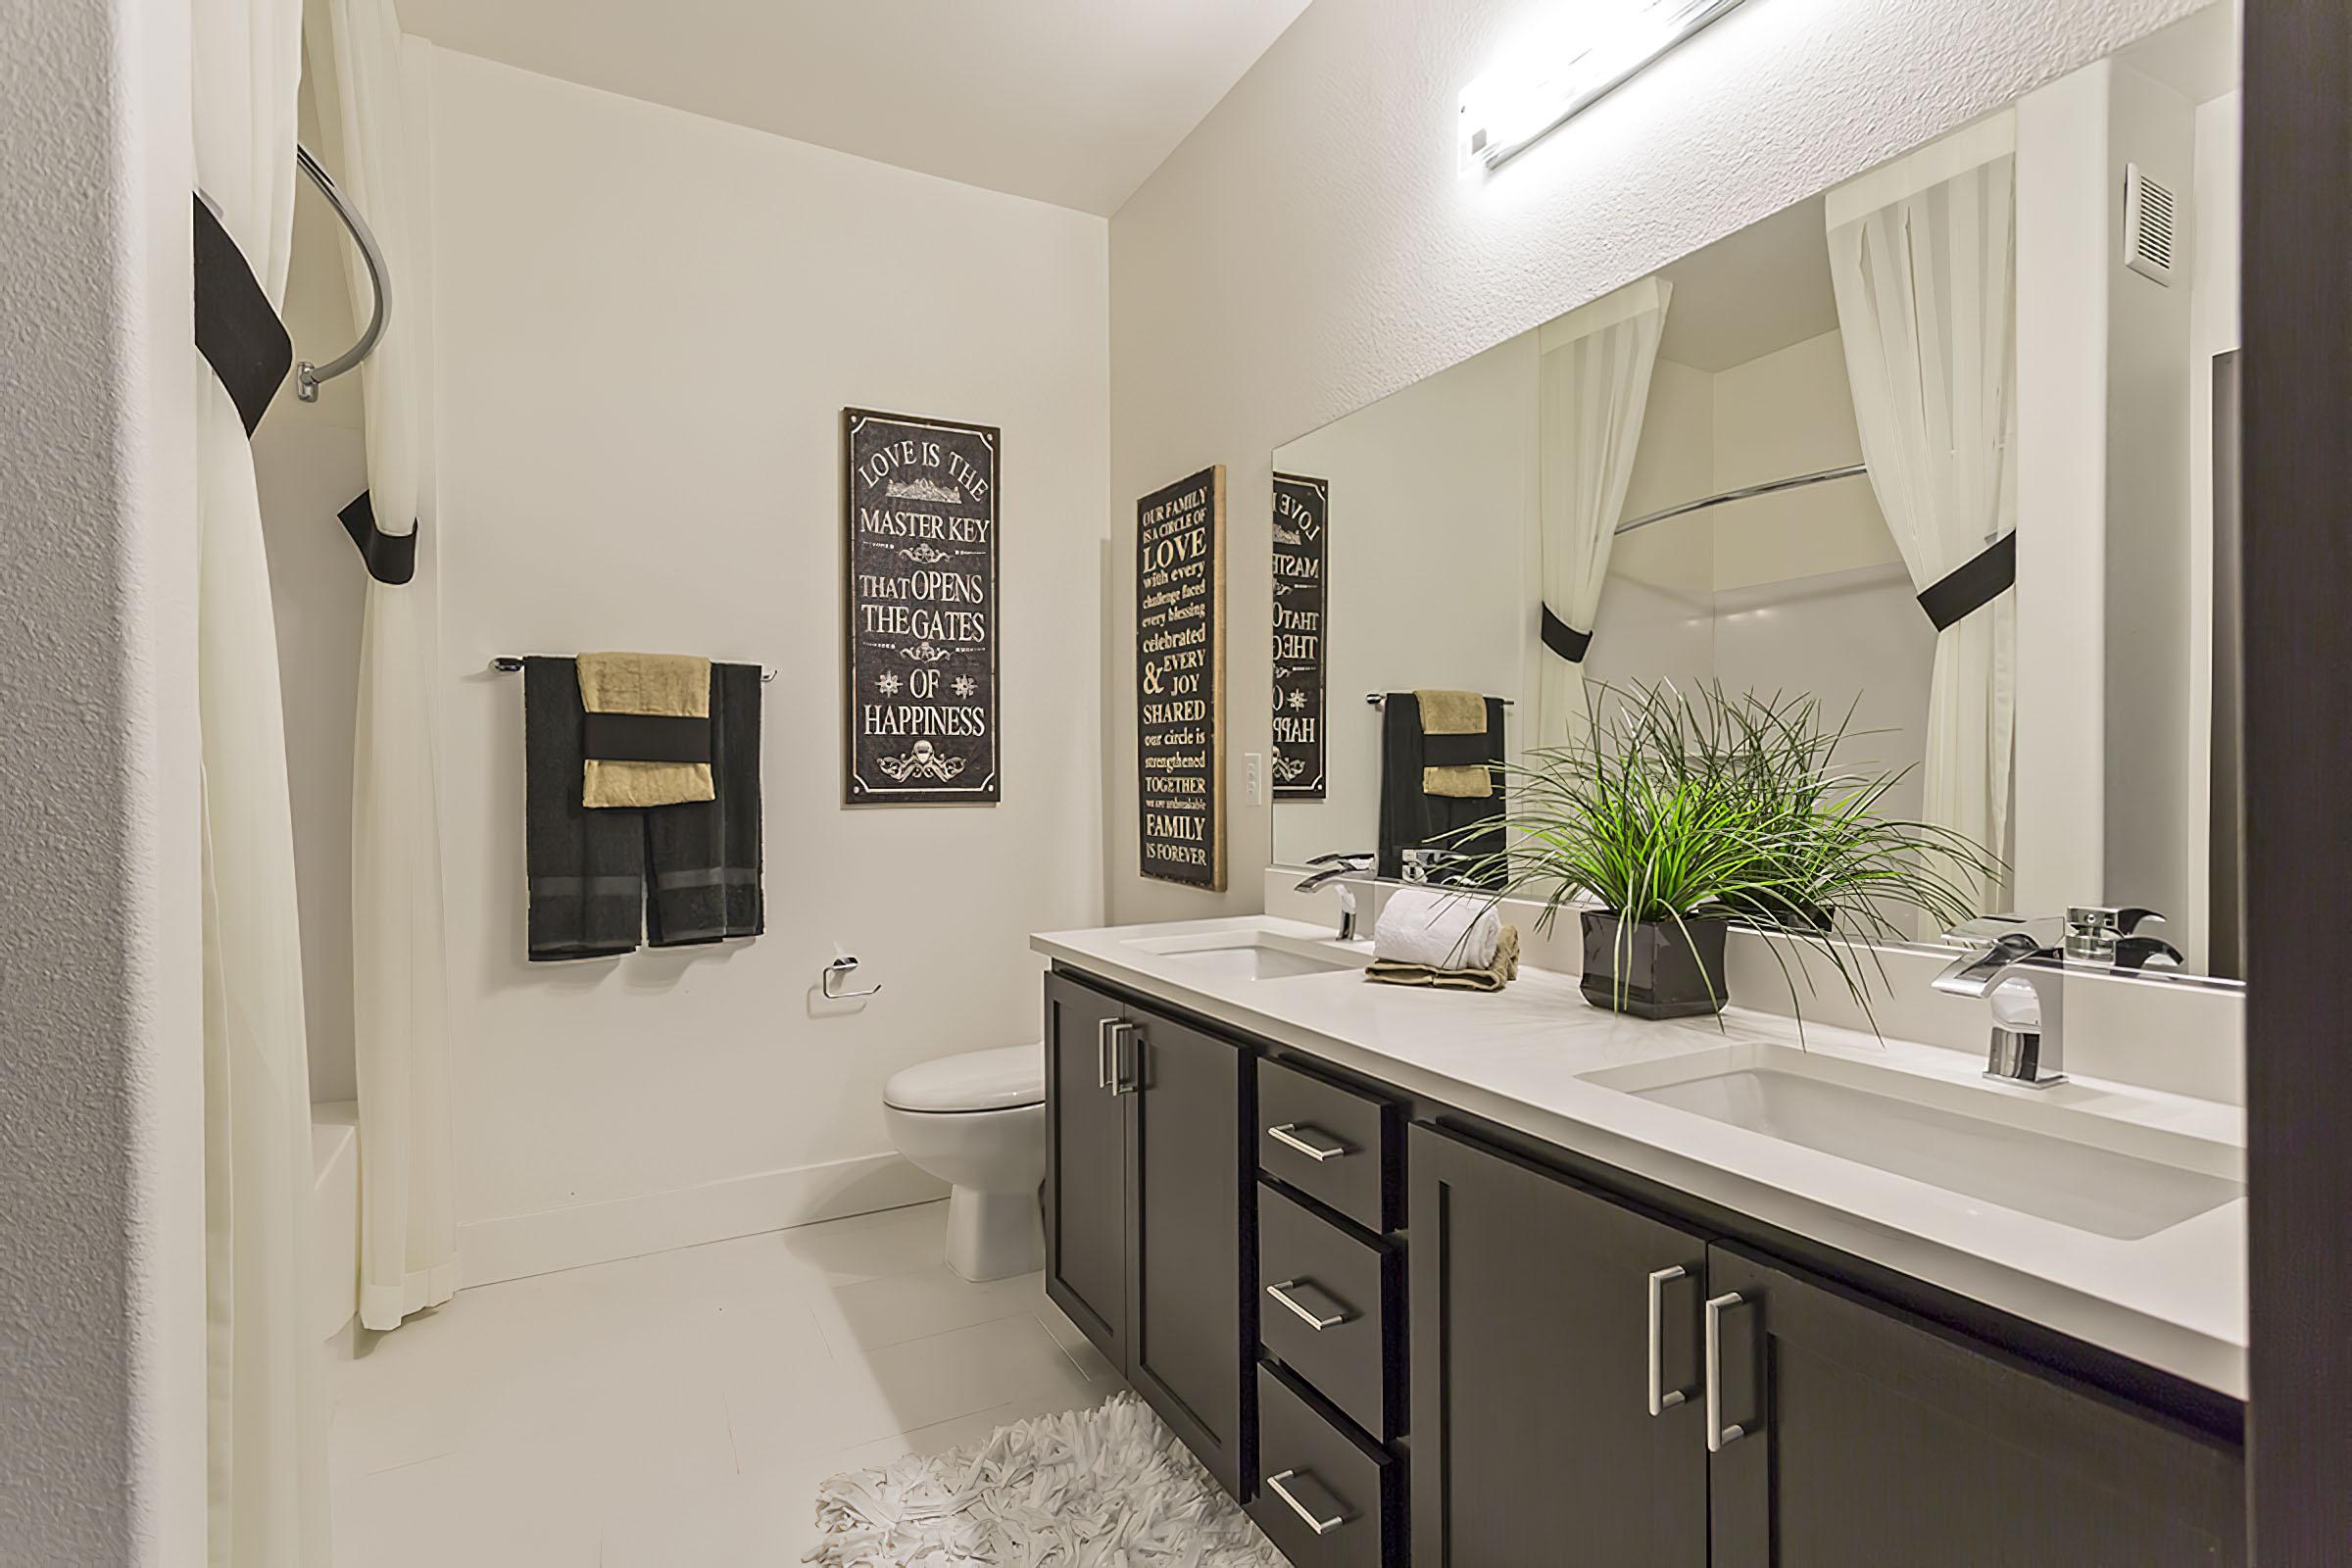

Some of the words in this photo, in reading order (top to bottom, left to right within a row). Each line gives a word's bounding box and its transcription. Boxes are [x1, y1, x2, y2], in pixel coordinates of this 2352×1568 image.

[858, 441, 916, 489] LOVE
[922, 442, 940, 467] IS
[949, 451, 989, 502] THE
[1143, 506, 1164, 526] OUR
[1166, 486, 1206, 518] FAMILY
[860, 508, 945, 539] MASTER
[949, 516, 990, 543] KEY
[1144, 529, 1152, 544] IS
[1152, 527, 1158, 540] A
[1159, 514, 1192, 537] CIRCLE
[1194, 508, 1206, 524] OF
[1144, 527, 1206, 573] LOVE
[859, 574, 909, 600] THAT
[911, 570, 983, 604] OPENS
[1144, 569, 1168, 588] with
[1171, 561, 1205, 580] every
[860, 605, 909, 635] THE
[911, 610, 985, 642] GATES
[1142, 612, 1165, 627] every
[1168, 602, 1205, 621] blessing
[1144, 622, 1205, 653] celebrated
[910, 668, 940, 699] OF
[1144, 662, 1164, 694] &
[1163, 649, 1205, 671] EVERY
[1171, 674, 1200, 696] JOY
[863, 705, 985, 736] HAPPINESS
[1144, 700, 1205, 724] SHARED
[1145, 735, 1161, 746] our
[1164, 727, 1193, 744] circle
[1196, 728, 1205, 744] is
[1145, 751, 1205, 773] strengthened
[1145, 777, 1206, 793] TOGETHER
[1147, 813, 1205, 841] FAMILY
[1146, 843, 1155, 858] IS
[1157, 844, 1206, 865] FOREVER
